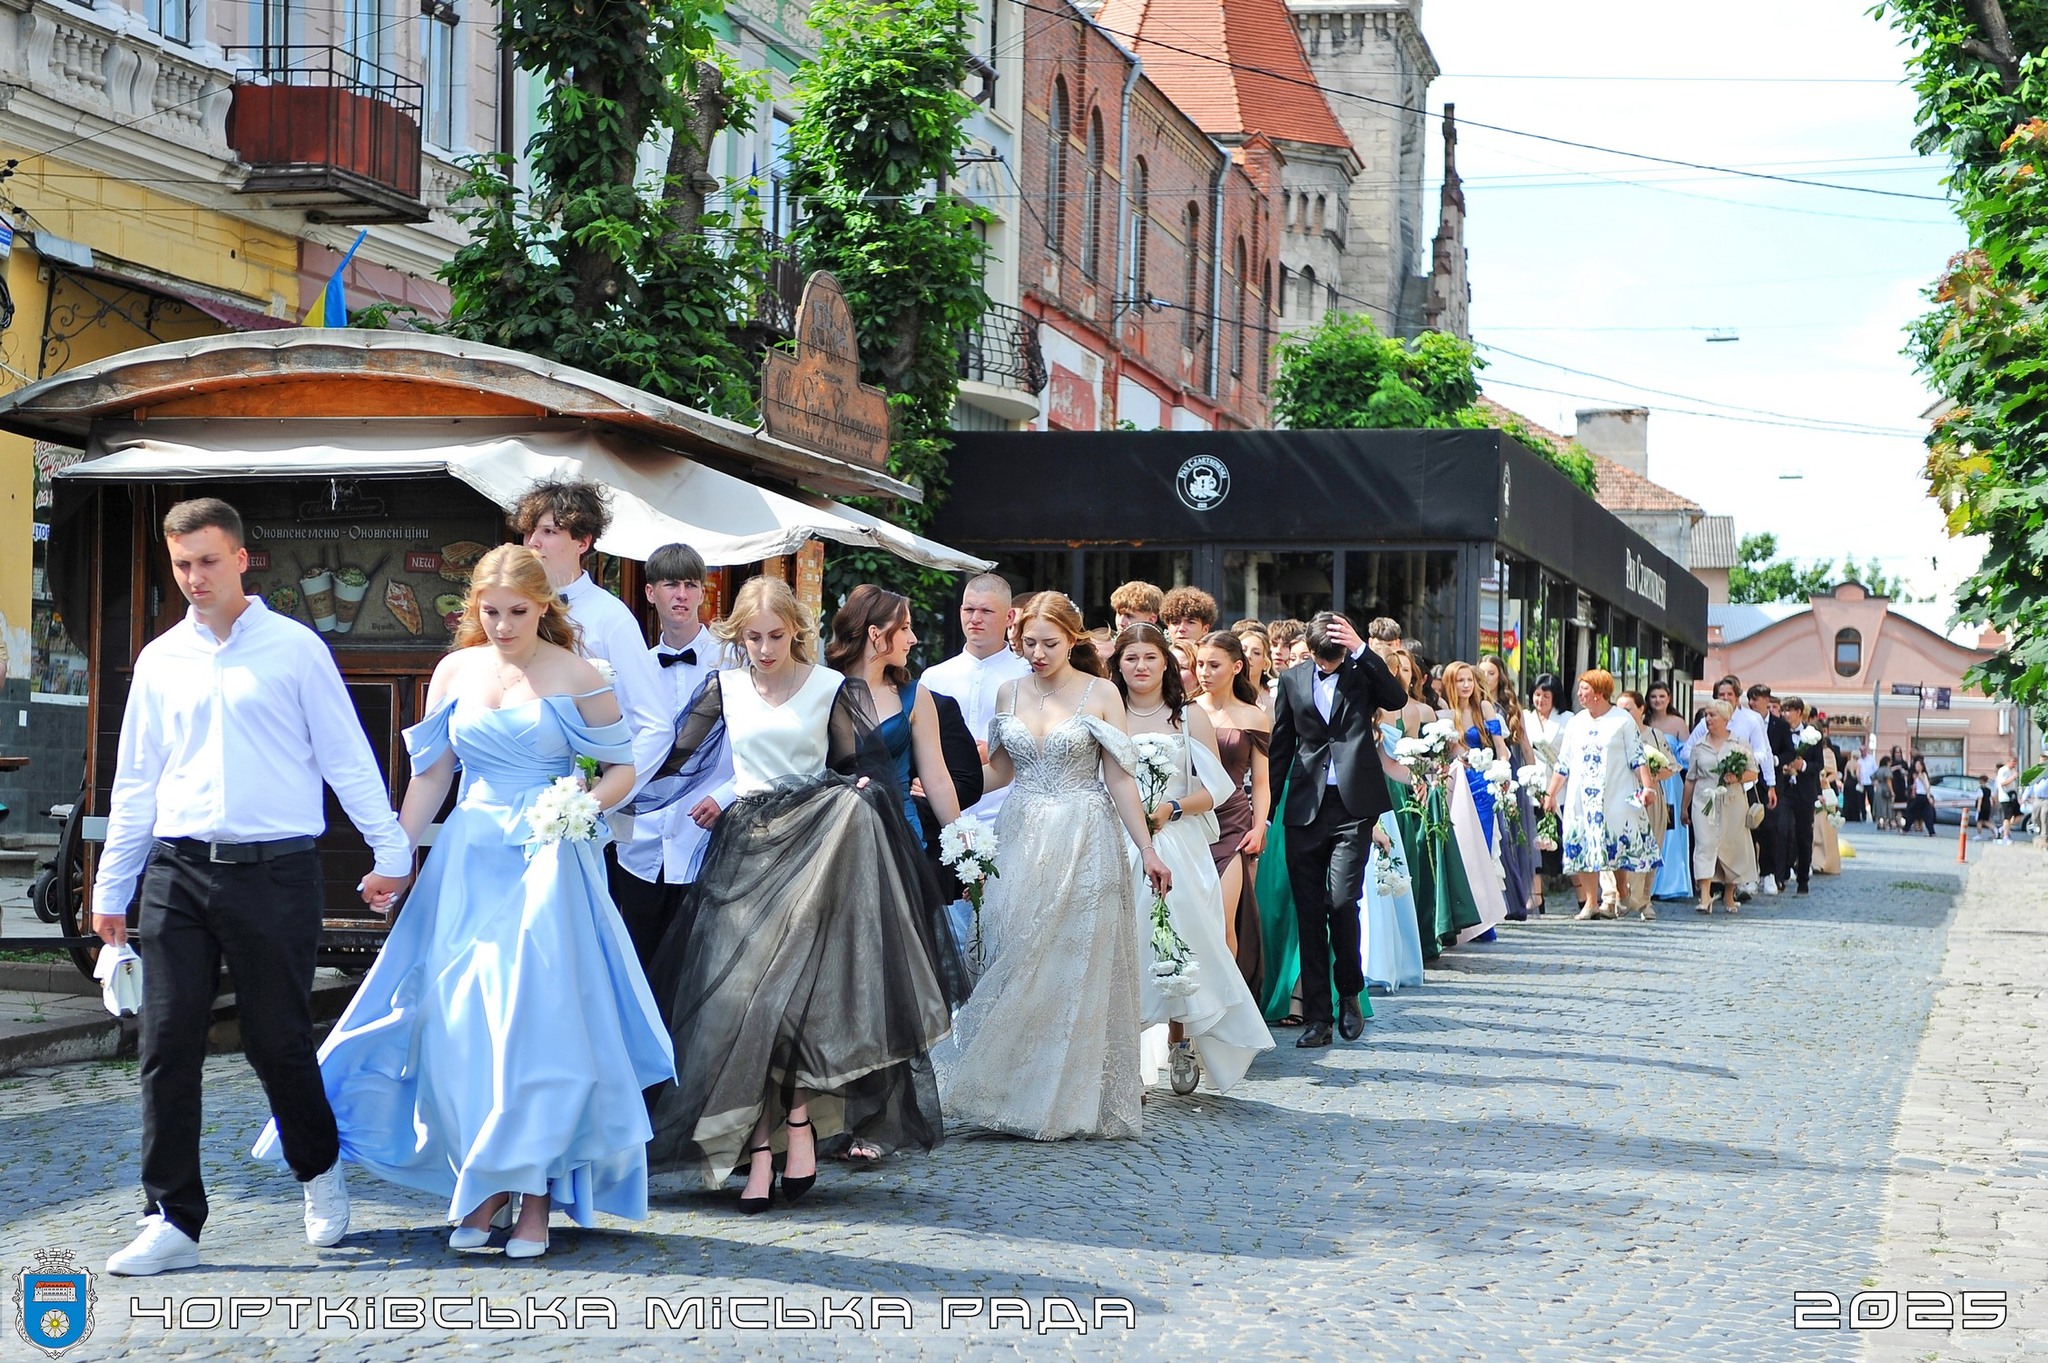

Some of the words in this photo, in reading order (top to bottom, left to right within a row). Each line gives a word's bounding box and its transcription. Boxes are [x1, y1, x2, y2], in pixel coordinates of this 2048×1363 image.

[252, 525, 306, 540] Оновлене
[308, 529, 340, 540] меню
[348, 525, 403, 541] Оновлені
[404, 526, 429, 541] ціни
